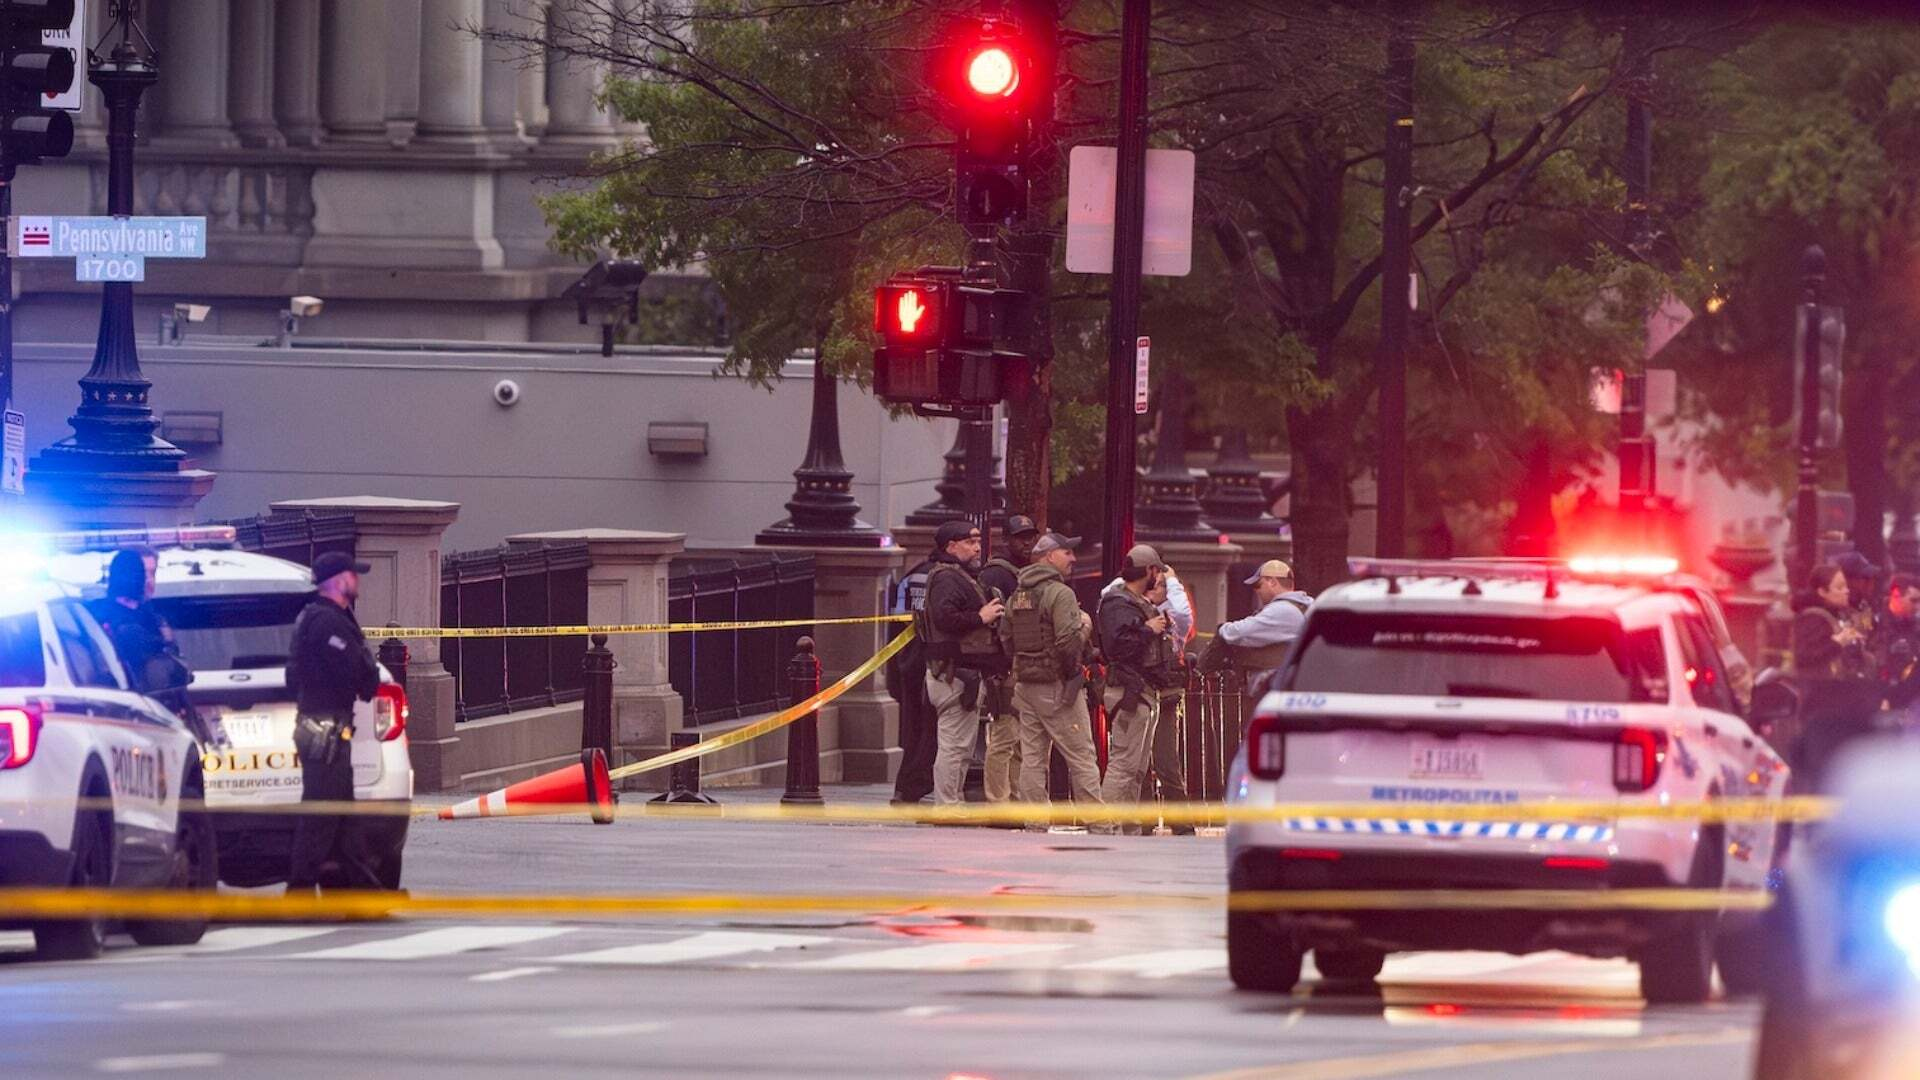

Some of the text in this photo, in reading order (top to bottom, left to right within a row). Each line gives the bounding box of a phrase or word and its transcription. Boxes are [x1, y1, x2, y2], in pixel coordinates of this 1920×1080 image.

[59, 221, 199, 254] Pennsylvania Ave
[180, 237, 196, 252] NW
[83, 260, 138, 279] 1700
[202, 752, 303, 772] OLIC
[111, 745, 154, 799] POLICE
[1371, 785, 1519, 804] METROPOLITAN
